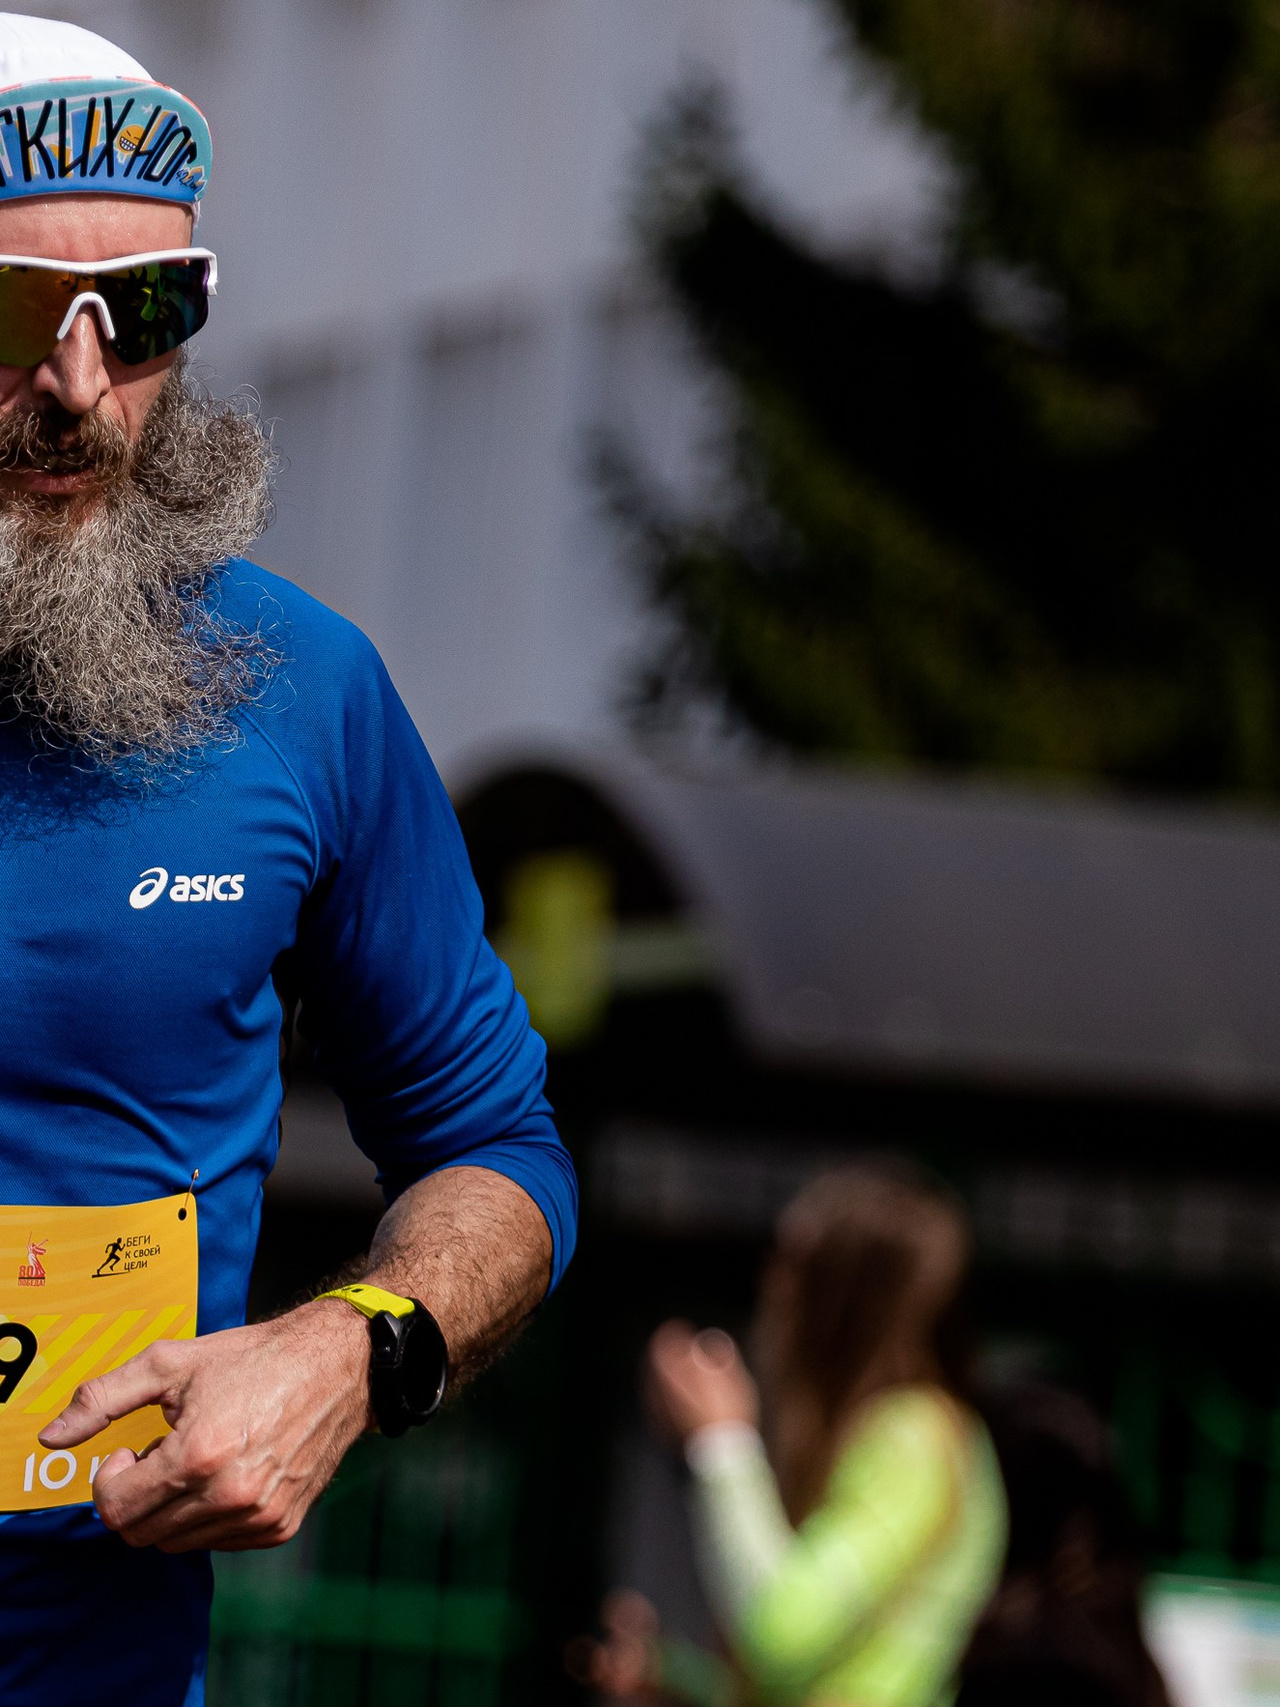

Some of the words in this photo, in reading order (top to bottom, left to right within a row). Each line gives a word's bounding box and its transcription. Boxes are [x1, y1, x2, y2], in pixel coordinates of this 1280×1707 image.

[122, 104, 198, 187] НОГ
[126, 1235, 151, 1248] БЕГИ
[124, 1250, 131, 1259] К
[133, 1244, 161, 1258] СВОЕЙ
[123, 1259, 148, 1272] ЦЕЛИ
[23, 1449, 77, 1492] 10
